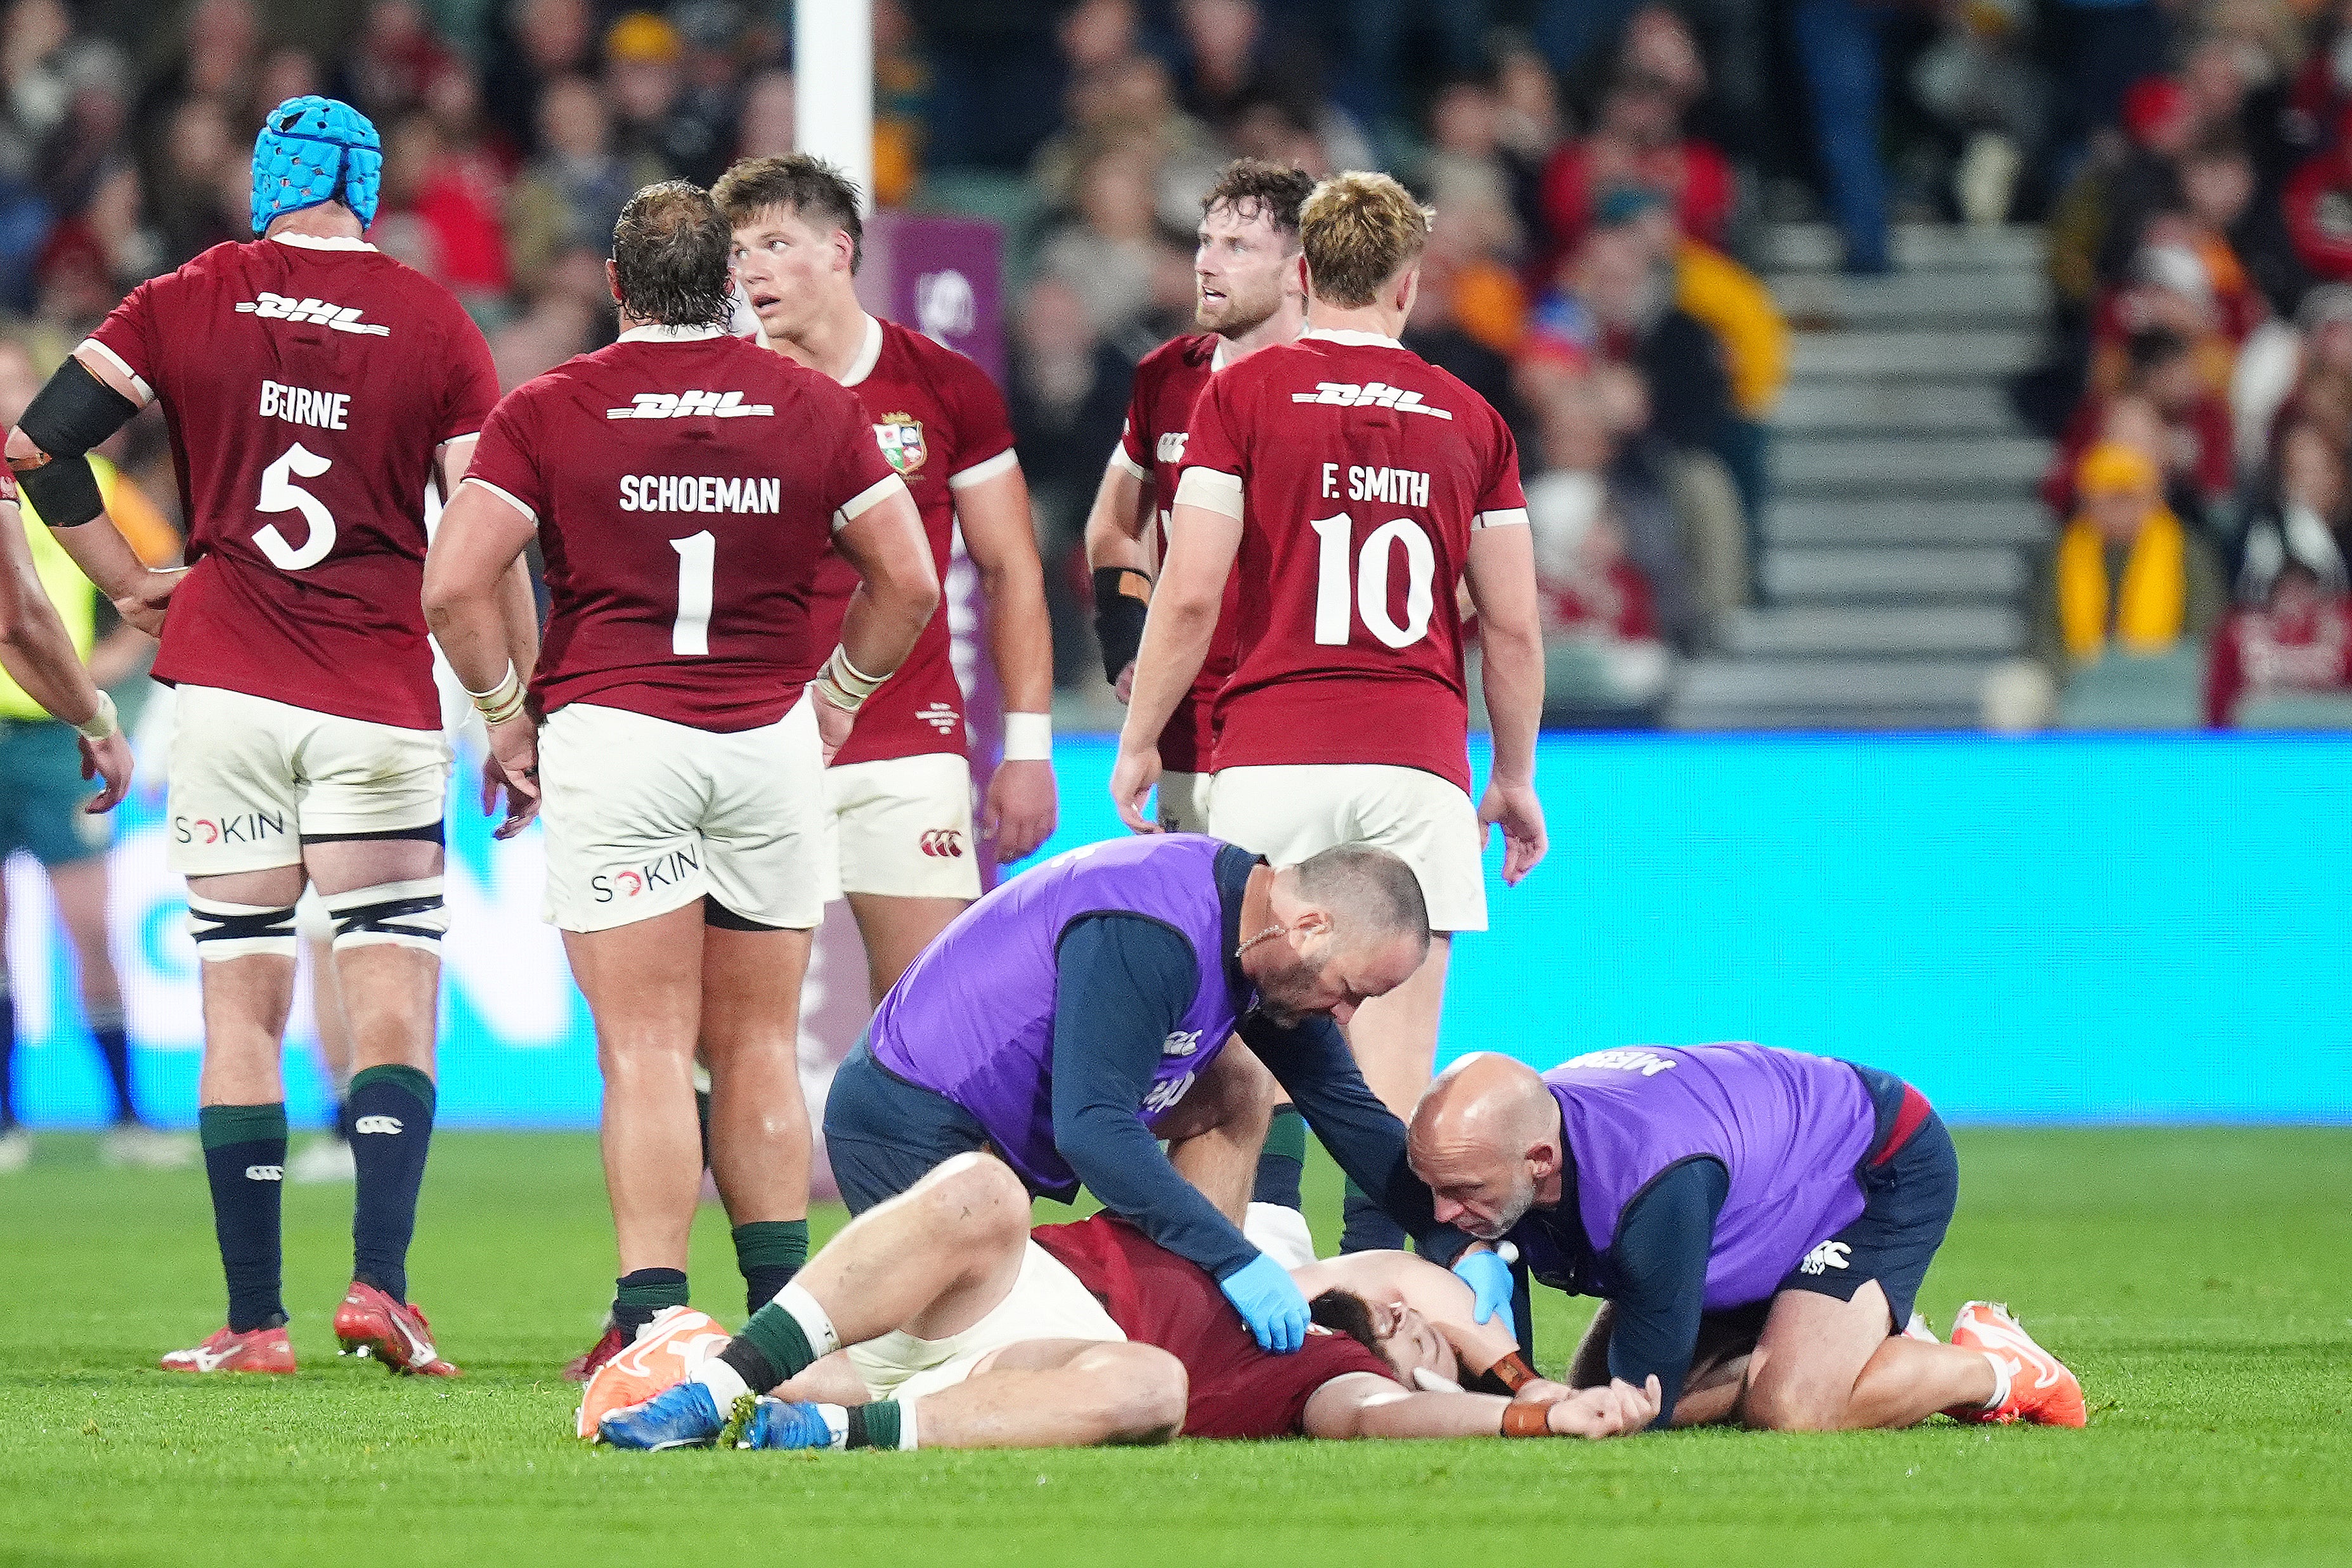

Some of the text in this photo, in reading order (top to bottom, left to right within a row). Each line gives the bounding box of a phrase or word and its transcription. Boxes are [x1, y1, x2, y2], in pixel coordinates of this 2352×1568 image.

[254, 292, 363, 334] DHL
[259, 380, 351, 431] BEIRNE
[629, 390, 752, 419] DHL
[1314, 382, 1434, 416] DHL
[251, 442, 336, 571] 5
[620, 475, 781, 514] SCHOEMAN
[1322, 463, 1430, 509] F. SMITH
[669, 529, 715, 656] 1
[1309, 512, 1436, 649] 10
